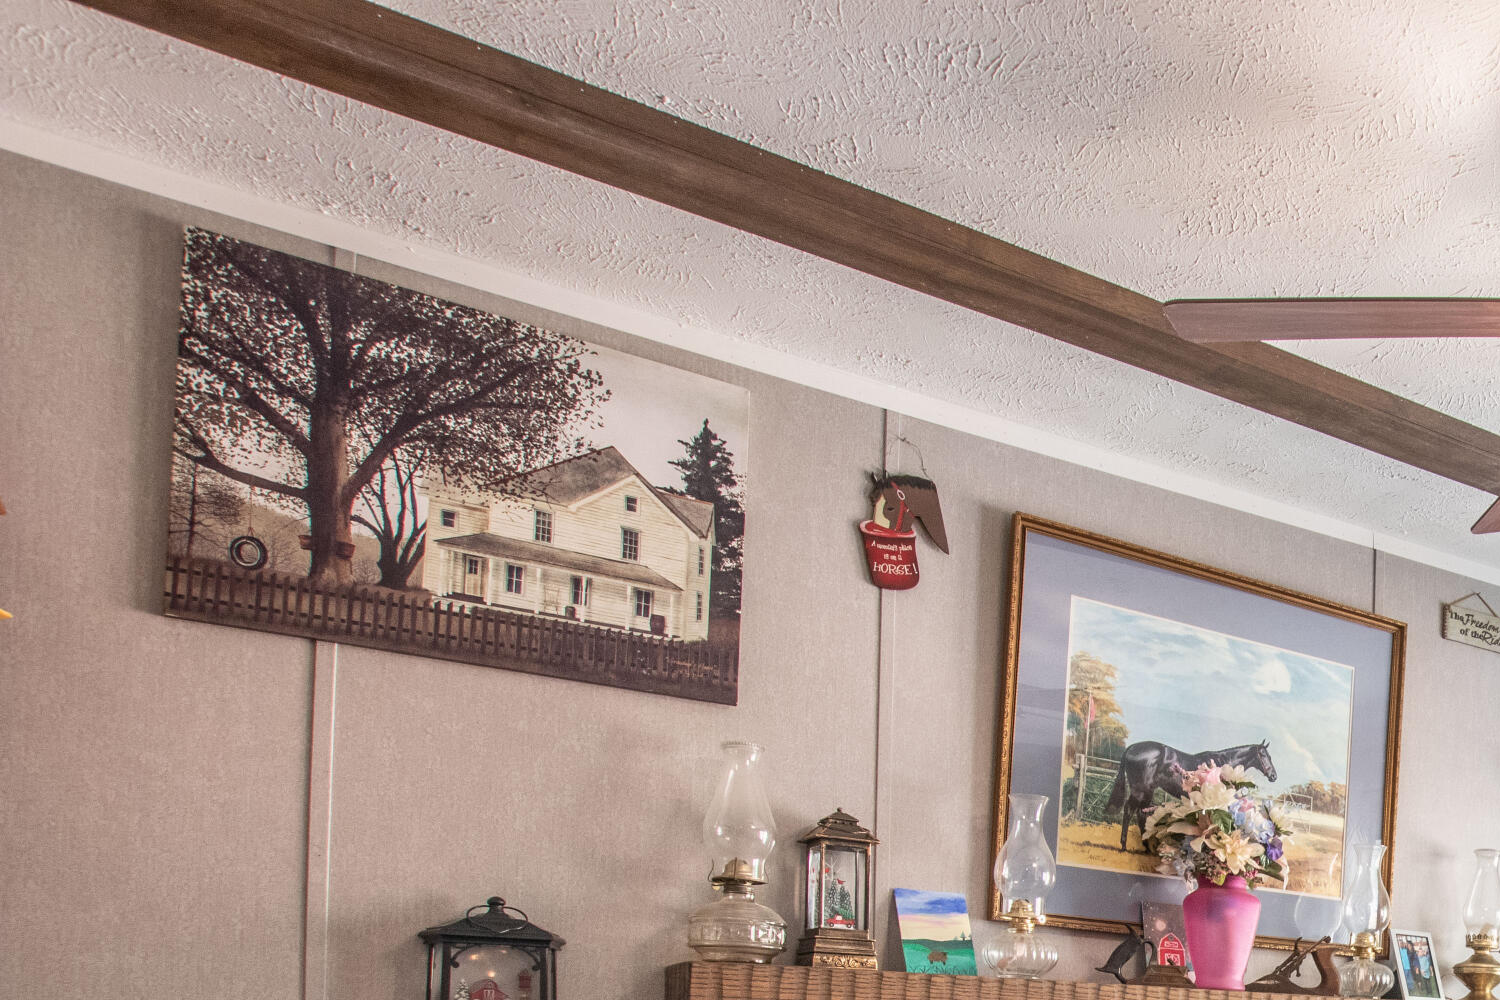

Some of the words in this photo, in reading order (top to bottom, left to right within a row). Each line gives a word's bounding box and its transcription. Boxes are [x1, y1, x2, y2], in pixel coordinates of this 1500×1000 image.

[1462, 613, 1500, 634] Freedom
[1459, 628, 1470, 636] of
[1470, 630, 1484, 640] the
